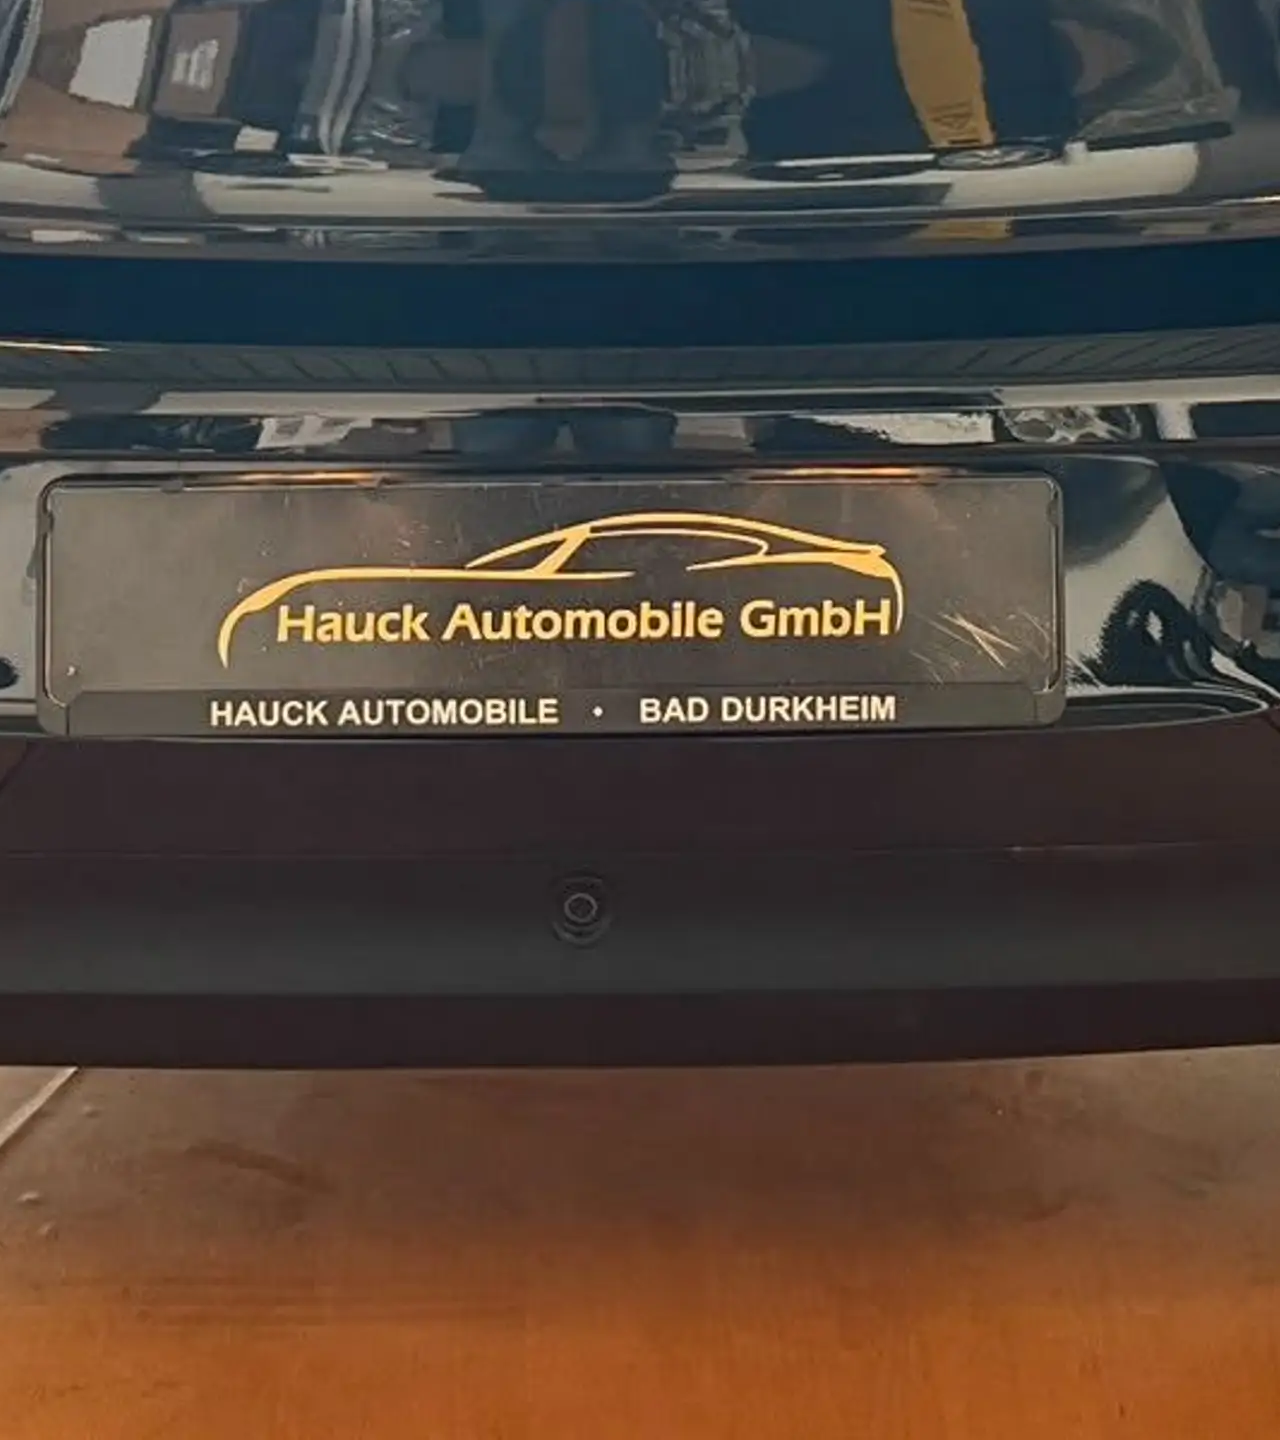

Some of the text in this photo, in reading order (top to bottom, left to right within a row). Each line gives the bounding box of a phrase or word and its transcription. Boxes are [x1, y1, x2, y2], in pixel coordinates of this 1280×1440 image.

[276, 598, 891, 643] Hauck Automobile GmbH
[210, 695, 897, 727] HAUCK AUTOMOBILE BAD DURKHEIM
